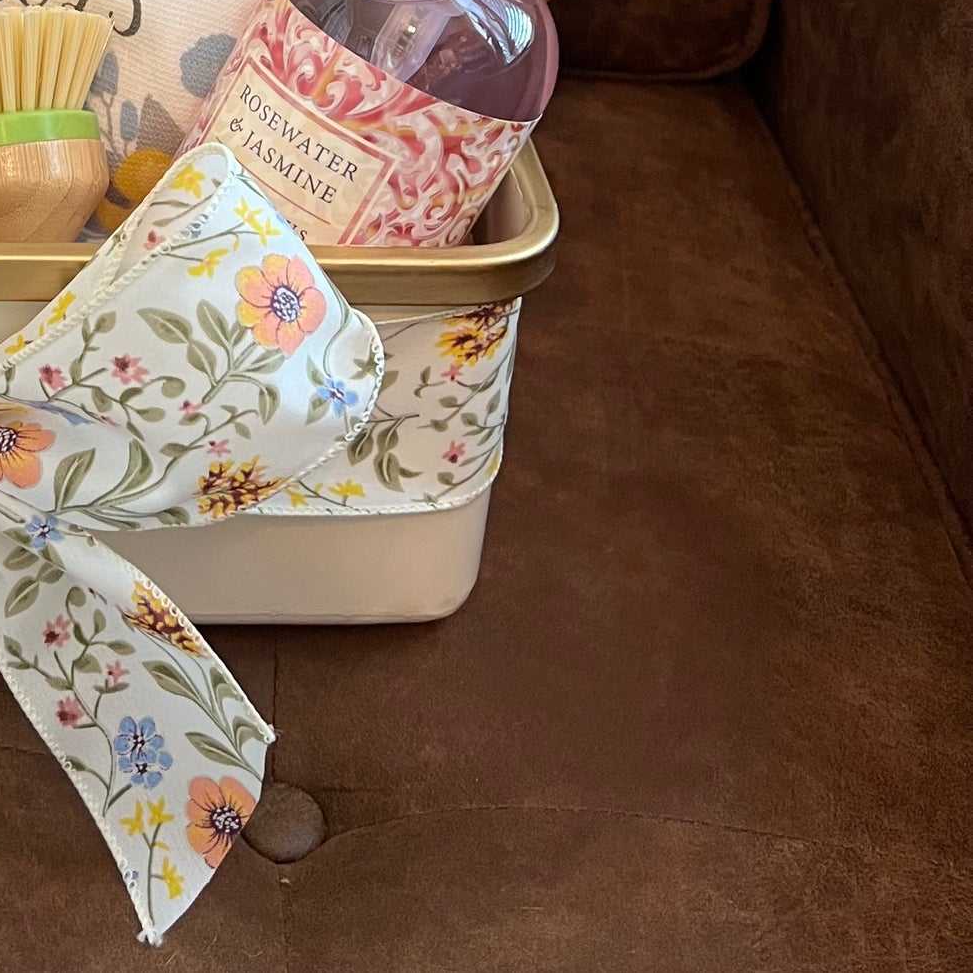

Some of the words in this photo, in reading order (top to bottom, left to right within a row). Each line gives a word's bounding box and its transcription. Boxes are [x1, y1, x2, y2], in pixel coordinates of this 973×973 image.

[230, 118, 244, 132] &
[242, 130, 338, 205] JASMINE
[239, 84, 359, 182] ROSEWATER
